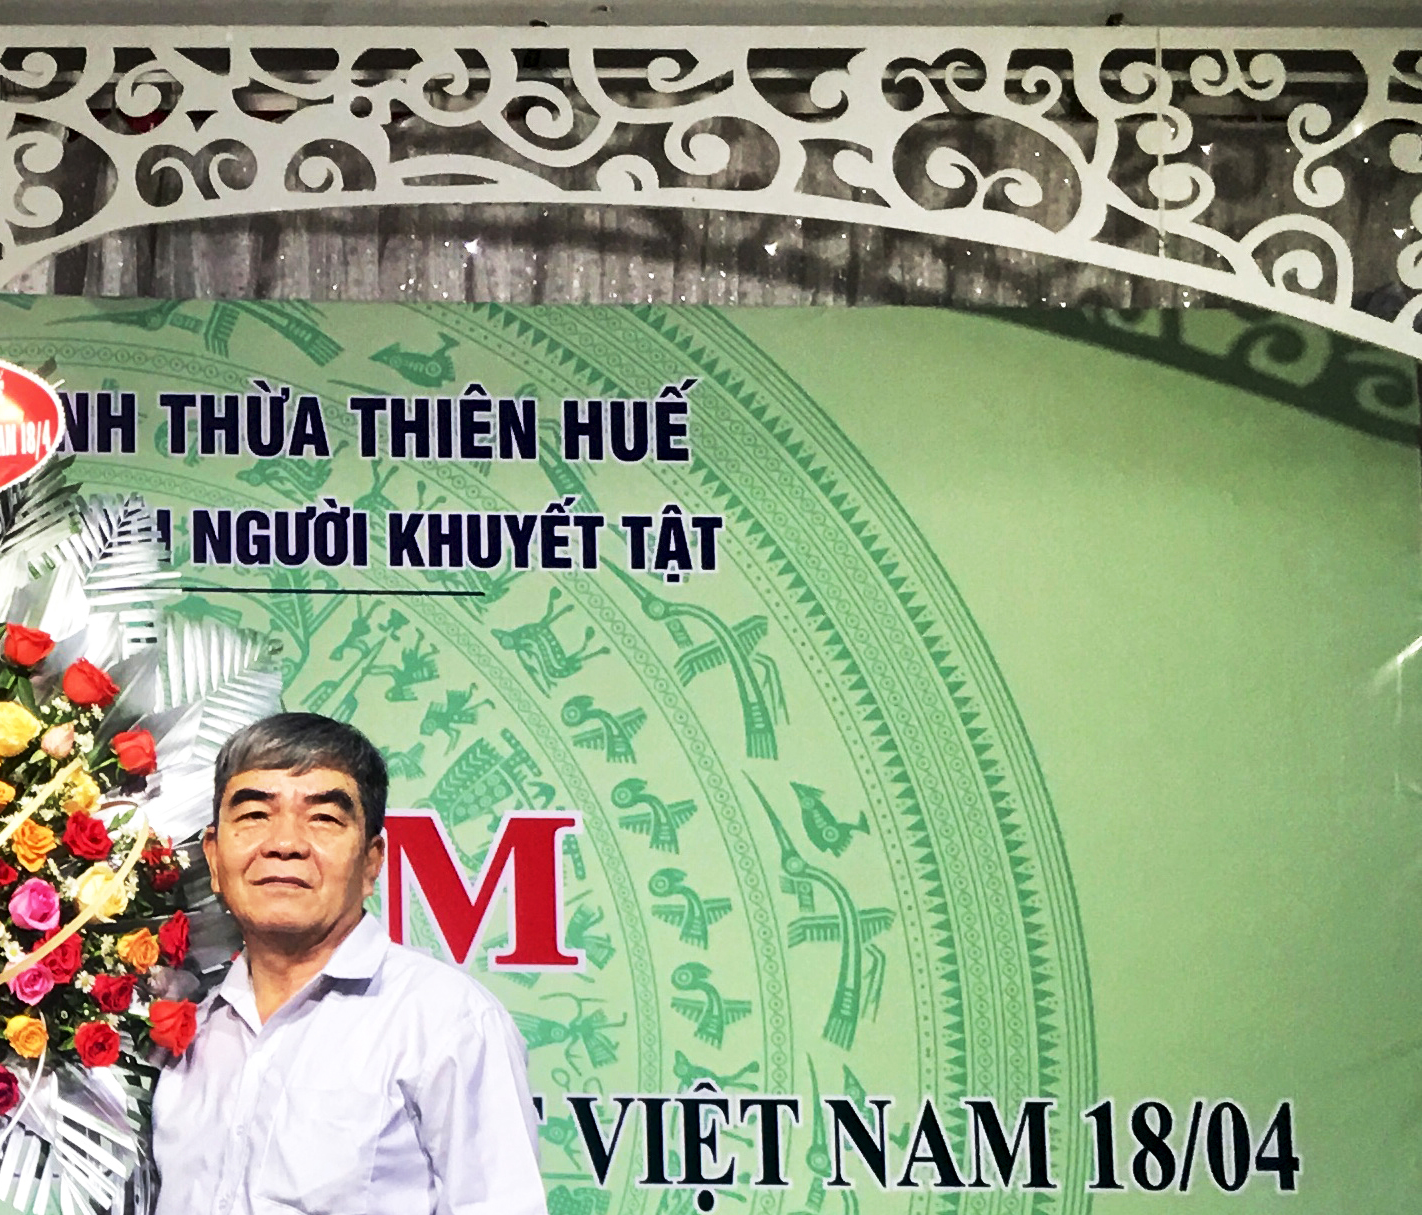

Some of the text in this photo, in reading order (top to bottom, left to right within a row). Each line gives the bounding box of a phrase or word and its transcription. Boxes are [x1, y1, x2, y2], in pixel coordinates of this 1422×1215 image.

[21, 418, 51, 461] 18/4
[160, 381, 330, 457] THỪA
[350, 384, 537, 460] THIÊN
[563, 378, 698, 462] HUẾ
[193, 498, 368, 567] NGƯỜI
[389, 497, 605, 570] KHUYẾT
[621, 504, 723, 583] TẬT
[566, 1083, 800, 1212] VIỆT
[825, 1099, 1057, 1189] NAM
[1086, 1100, 1300, 1192] 18/04
